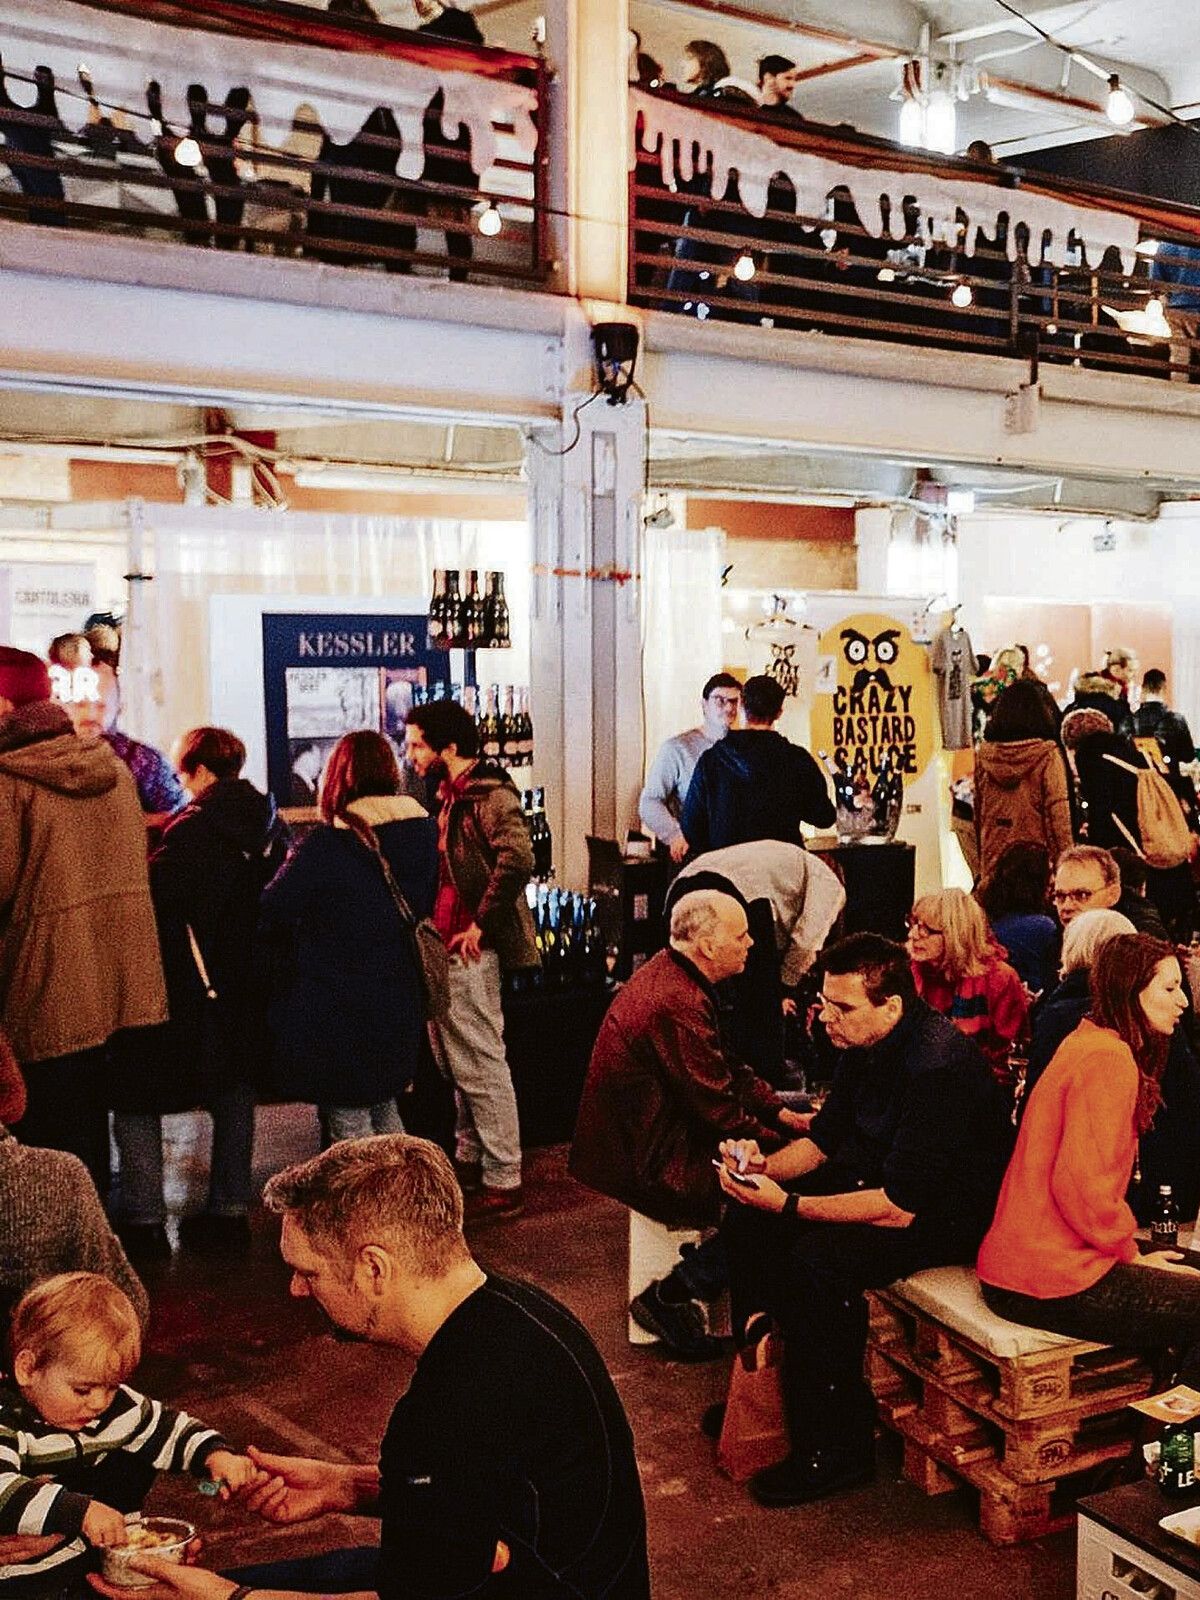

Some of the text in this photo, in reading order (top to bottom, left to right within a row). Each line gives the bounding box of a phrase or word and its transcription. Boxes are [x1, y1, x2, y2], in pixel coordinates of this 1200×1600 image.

[299, 631, 416, 658] KESSLER
[832, 685, 913, 716] CRAZY
[833, 715, 916, 746] BASTARD
[833, 744, 918, 776] SAUCE
